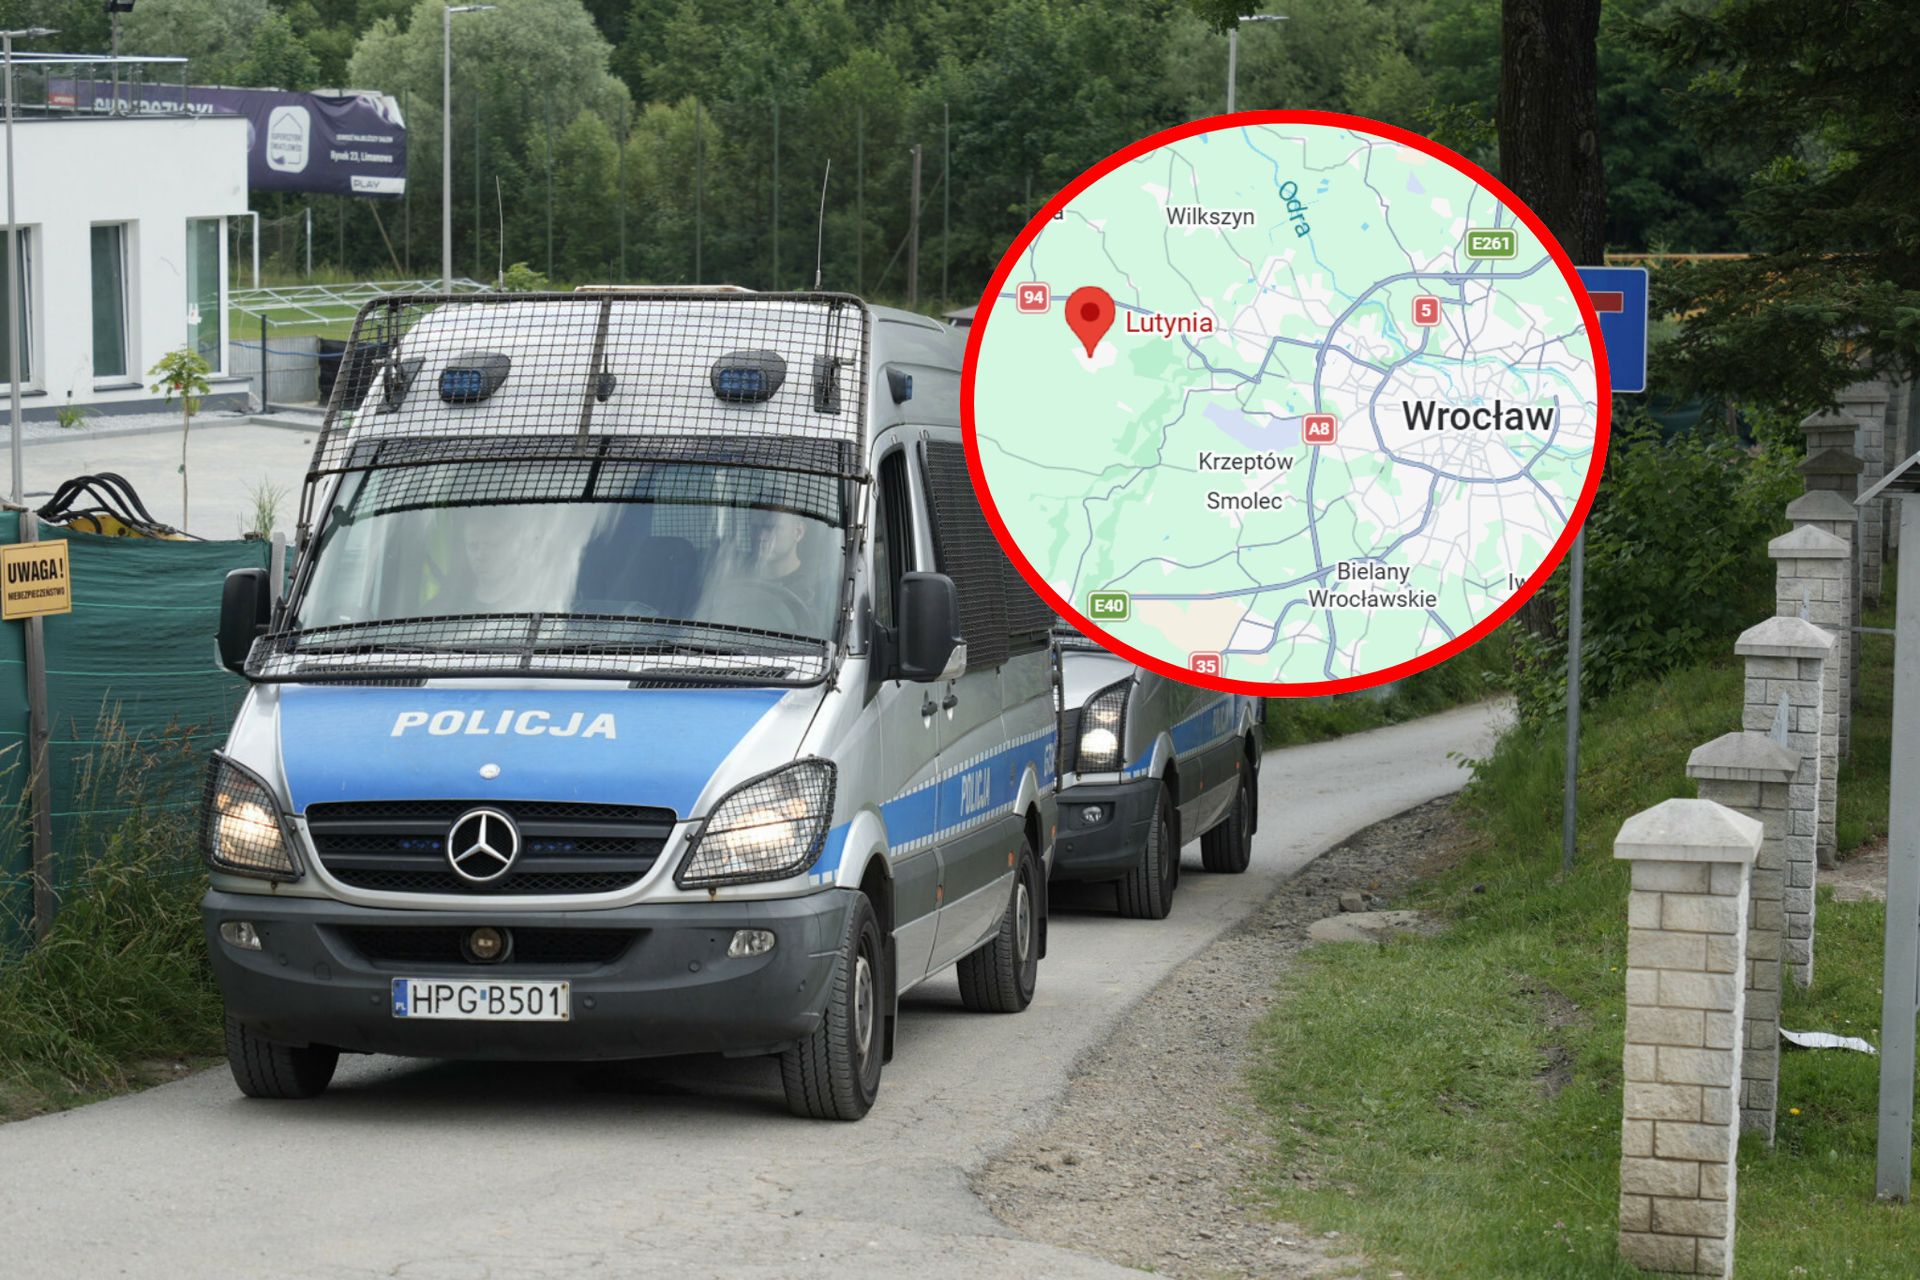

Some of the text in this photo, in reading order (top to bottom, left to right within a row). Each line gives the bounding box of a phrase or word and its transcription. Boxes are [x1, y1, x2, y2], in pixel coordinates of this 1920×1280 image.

[353, 179, 380, 188] PLAY
[390, 710, 616, 739] POLICJA
[960, 766, 991, 817] POLICJA
[412, 984, 559, 1016] HPG B501
